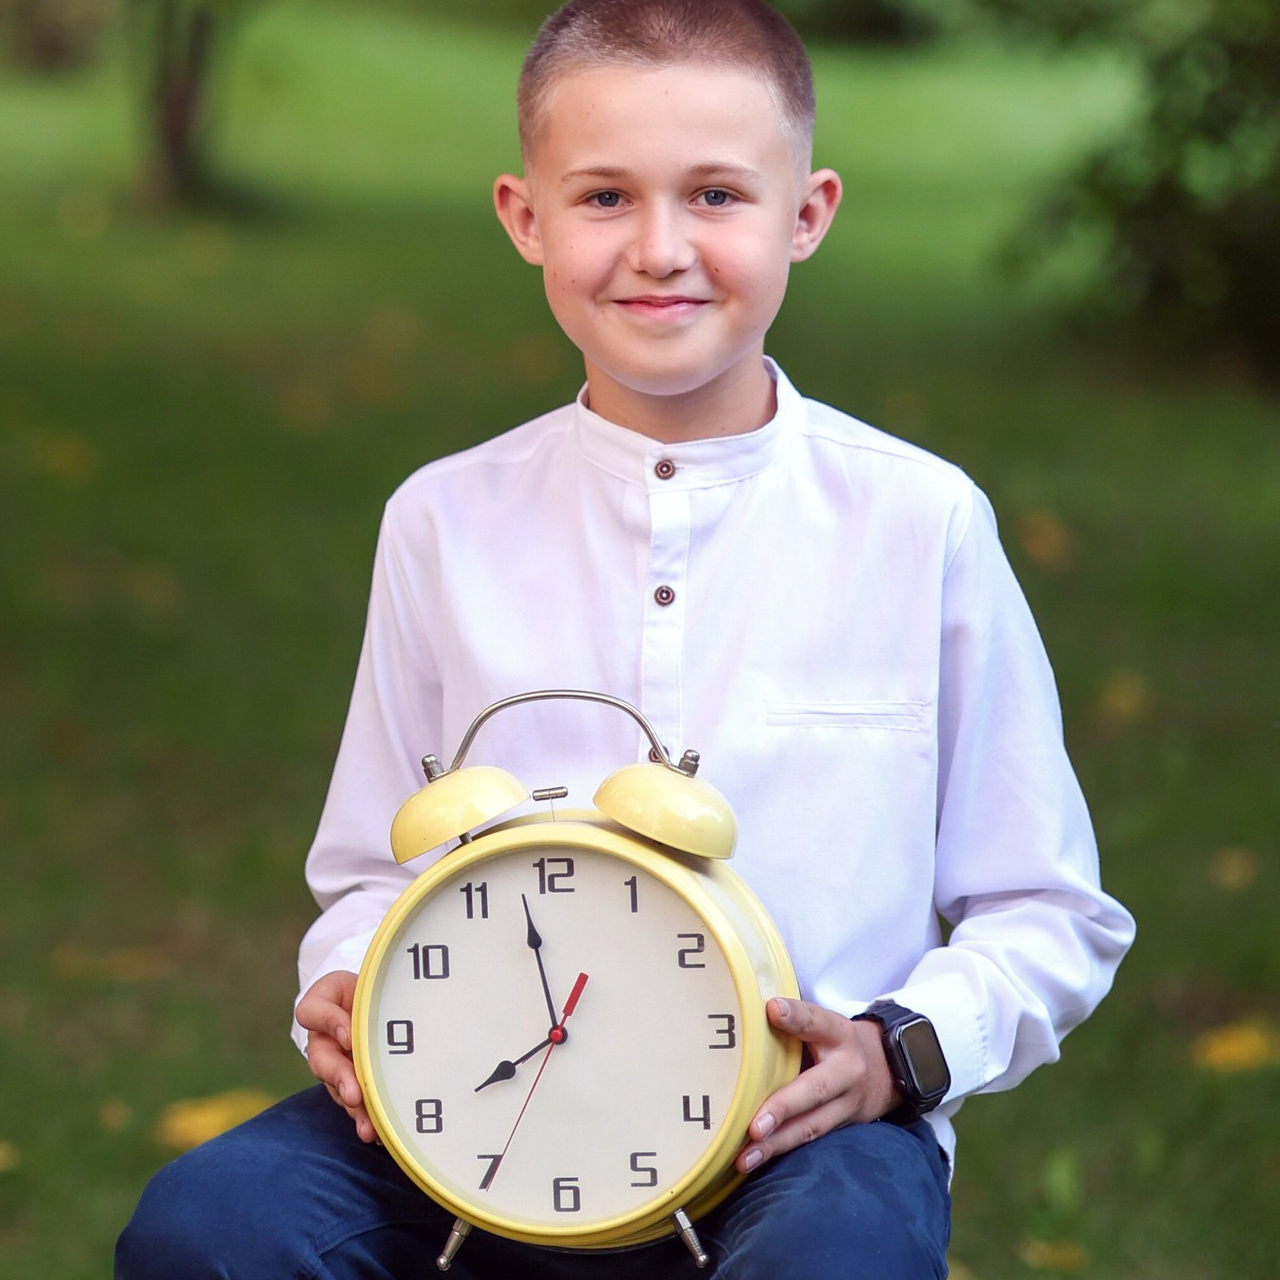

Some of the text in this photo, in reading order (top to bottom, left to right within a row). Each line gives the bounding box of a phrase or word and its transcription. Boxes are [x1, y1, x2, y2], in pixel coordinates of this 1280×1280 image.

[533, 857, 576, 894] 12
[460, 882, 489, 919] 11
[624, 876, 638, 913] 1
[407, 943, 450, 980] 10
[677, 933, 705, 969] 2
[386, 1019, 414, 1055] 9
[708, 1014, 736, 1050] 3
[415, 1098, 443, 1134] 8
[683, 1095, 711, 1130] 4
[477, 1154, 504, 1190] 7
[630, 1152, 658, 1187] 5
[553, 1177, 581, 1213] 6
